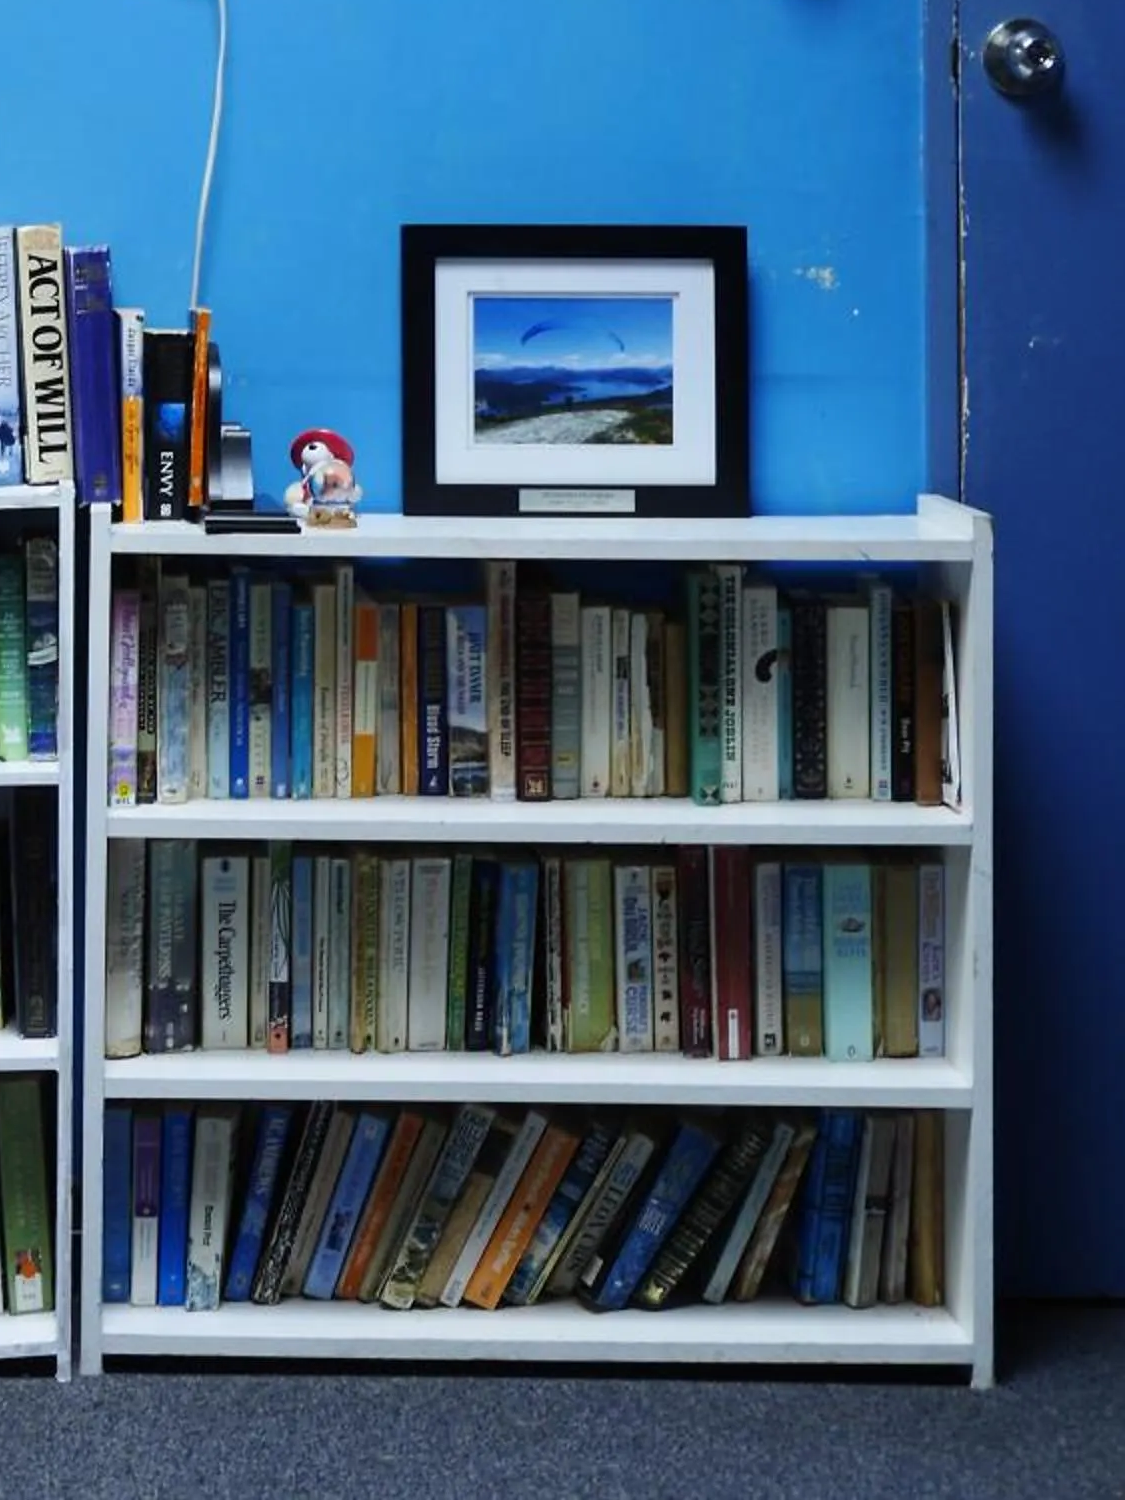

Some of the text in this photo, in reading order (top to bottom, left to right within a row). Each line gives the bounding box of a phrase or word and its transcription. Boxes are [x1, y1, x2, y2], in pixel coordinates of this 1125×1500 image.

[26, 253, 67, 463] ACT OF WILL
[159, 451, 174, 497] ENVY
[210, 631, 226, 704] AMBLER
[218, 900, 236, 925] The
